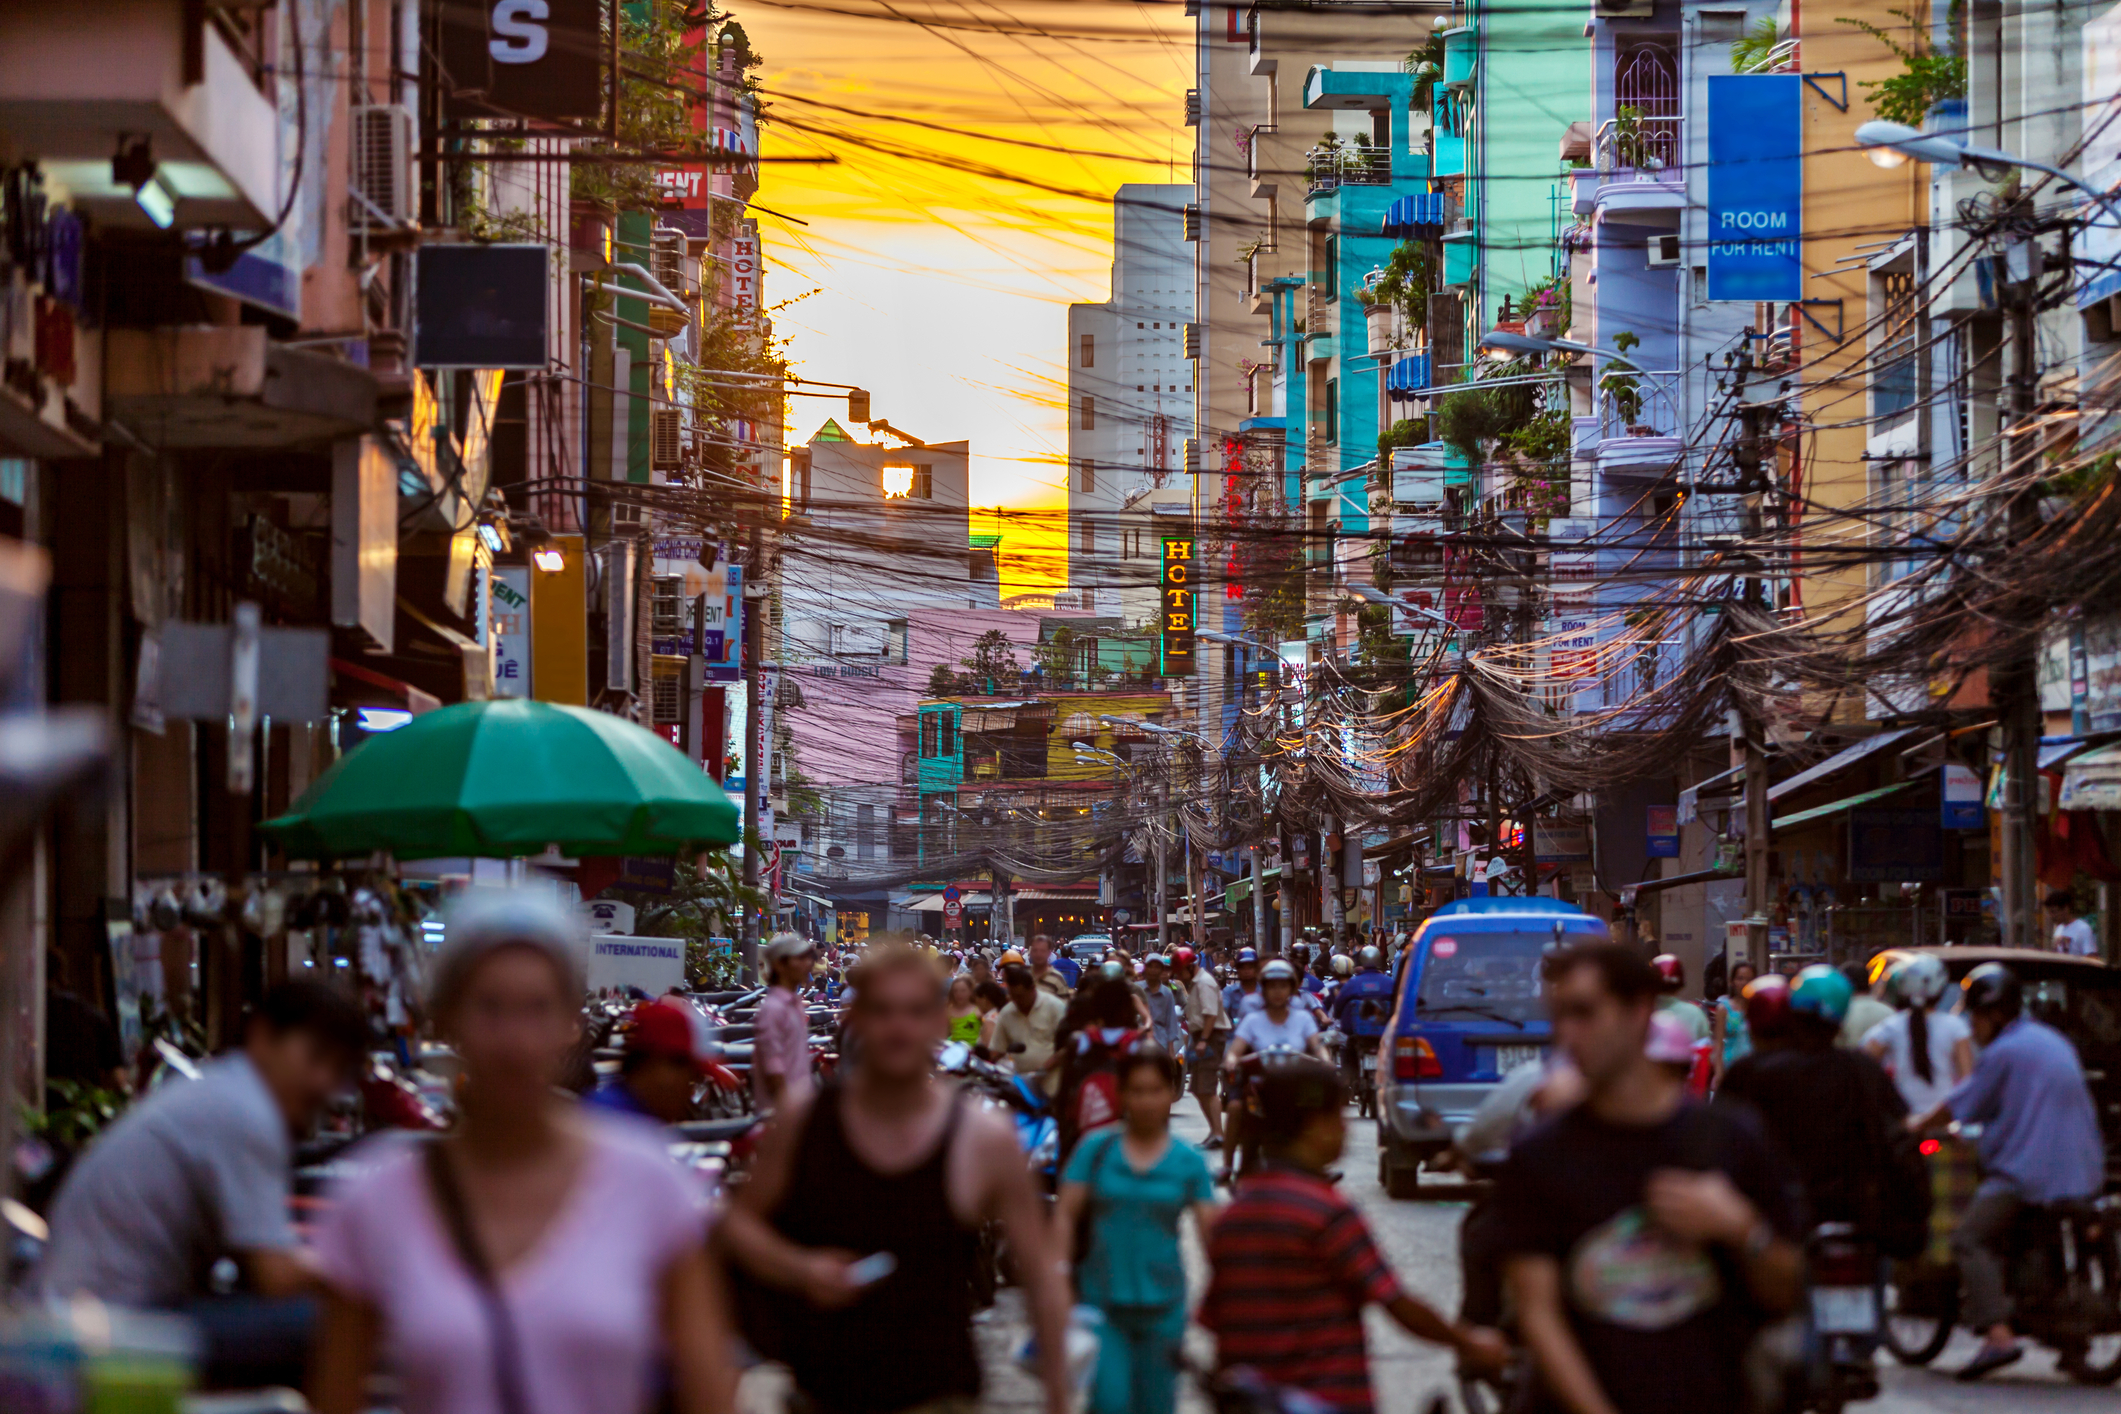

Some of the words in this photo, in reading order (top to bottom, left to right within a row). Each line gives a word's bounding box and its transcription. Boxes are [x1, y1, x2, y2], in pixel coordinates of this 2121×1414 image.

[1721, 211, 1787, 229] ROOM
[1711, 240, 1745, 256] FOR
[1751, 240, 1796, 256] RENT
[734, 241, 754, 327] HOTEL
[1165, 541, 1192, 656] HOTEL
[704, 606, 723, 623] ENT
[1561, 621, 1587, 632] ROOM
[706, 637, 719, 645] Q.1
[1572, 636, 1595, 648] RENT
[841, 666, 881, 678] BUDGET
[774, 839, 797, 848] OUR
[595, 943, 679, 959] INTERNATIONAL
